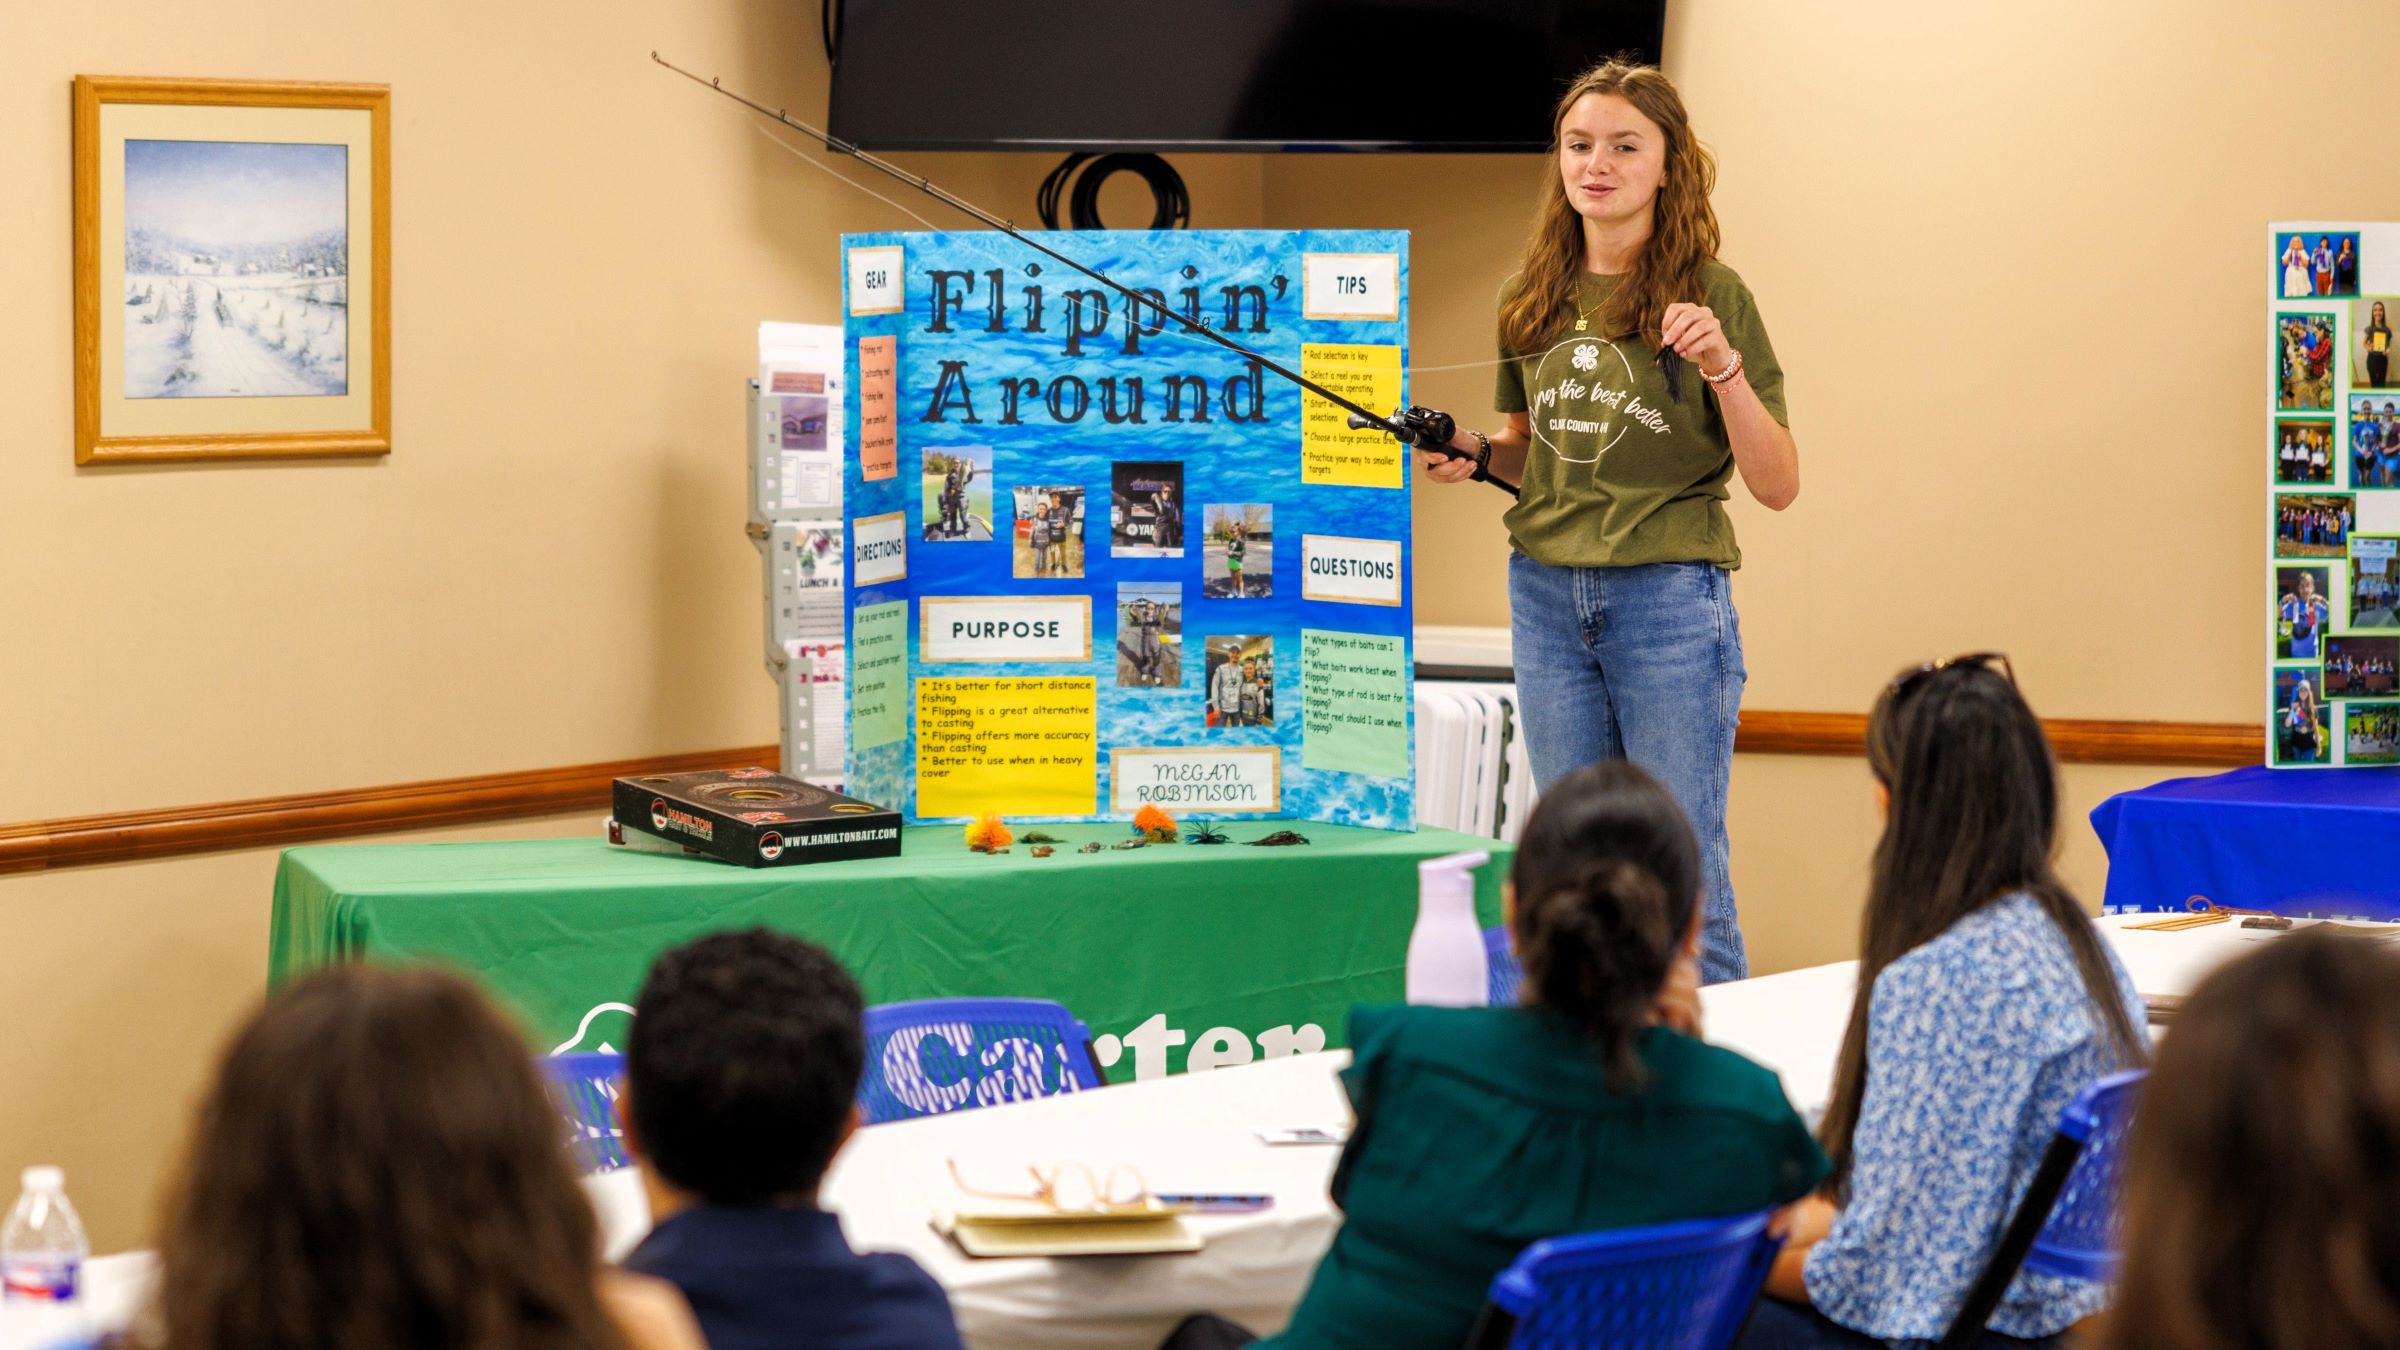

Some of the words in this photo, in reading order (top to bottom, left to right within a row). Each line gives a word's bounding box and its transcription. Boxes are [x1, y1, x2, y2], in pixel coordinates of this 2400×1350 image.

[866, 270, 886, 289] GEAR
[1337, 276, 1367, 294] TIPS
[924, 262, 1289, 356] Flippin'
[1310, 351, 1321, 359] Rod
[1358, 352, 1368, 362] key
[1311, 371, 1328, 379] Select
[1337, 371, 1348, 380] reel
[1351, 374, 1361, 382] you
[919, 360, 1270, 424] Around
[1346, 384, 1373, 396] operating
[1311, 400, 1326, 408] Start
[1559, 378, 1586, 400] the
[1591, 381, 1627, 410] best
[1624, 397, 1671, 434] better
[1310, 413, 1338, 422] selections
[1567, 419, 1600, 434] COUNTY
[1311, 433, 1330, 441] Choose
[1339, 434, 1353, 445] large
[1357, 435, 1380, 444] practice
[1309, 452, 1333, 461] Practice
[1336, 456, 1348, 464] your
[1351, 457, 1361, 466] way
[1364, 456, 1370, 464] to
[1373, 456, 1394, 465] smaller
[1309, 466, 1331, 476] targets
[857, 539, 901, 563] DIRECTIONS
[1310, 556, 1394, 580] QUESTIONS
[800, 578, 829, 588] LUNCH
[953, 621, 1060, 638] PURPOSE
[1312, 635, 1328, 645] What
[1331, 638, 1347, 648] types
[1350, 639, 1357, 648] of
[1359, 640, 1374, 650] baits
[1389, 642, 1393, 651] I
[1305, 647, 1319, 658] flip?
[1312, 661, 1328, 670] What
[1332, 663, 1346, 672] baits
[1349, 664, 1363, 672] work
[1366, 665, 1379, 674] best
[1382, 668, 1396, 676] when
[1305, 672, 1332, 685] flipping?
[932, 682, 951, 691] It's
[956, 681, 990, 691] better
[995, 681, 1011, 690] for
[1016, 681, 1043, 690] short
[1048, 681, 1091, 690] distance
[922, 694, 957, 705] fishing
[1312, 685, 1329, 695] What
[1332, 688, 1345, 698] type
[1348, 689, 1354, 697] of
[1357, 691, 1367, 699] rod
[1370, 692, 1375, 700] is
[1377, 691, 1391, 701] best
[1394, 693, 1403, 702] for
[1306, 696, 1331, 710] flipping?
[932, 706, 971, 717] Flipping
[976, 707, 984, 715] is
[1000, 707, 1028, 718] great
[1033, 706, 1089, 715] alternative
[1312, 710, 1329, 719] What
[1332, 713, 1344, 721] reel
[1347, 713, 1365, 725] should
[1368, 715, 1372, 725] I
[1387, 718, 1402, 728] when
[937, 720, 974, 729] casting
[1306, 721, 1332, 735] flipping?
[932, 731, 971, 742] Flipping
[976, 731, 1010, 740] offers
[1044, 732, 1090, 741] accuracy
[922, 744, 945, 753] than
[950, 745, 986, 754] casting
[932, 756, 967, 765] Better
[972, 757, 982, 765] to
[1009, 756, 1034, 764] when
[1040, 756, 1048, 764] in
[1053, 755, 1083, 766] heavy
[1153, 763, 1240, 781] MEGAN
[1137, 784, 1257, 802] ROBINSON
[668, 808, 712, 832] HAMILTON
[784, 827, 897, 848] WWW.HAMILTONBAIT.COM
